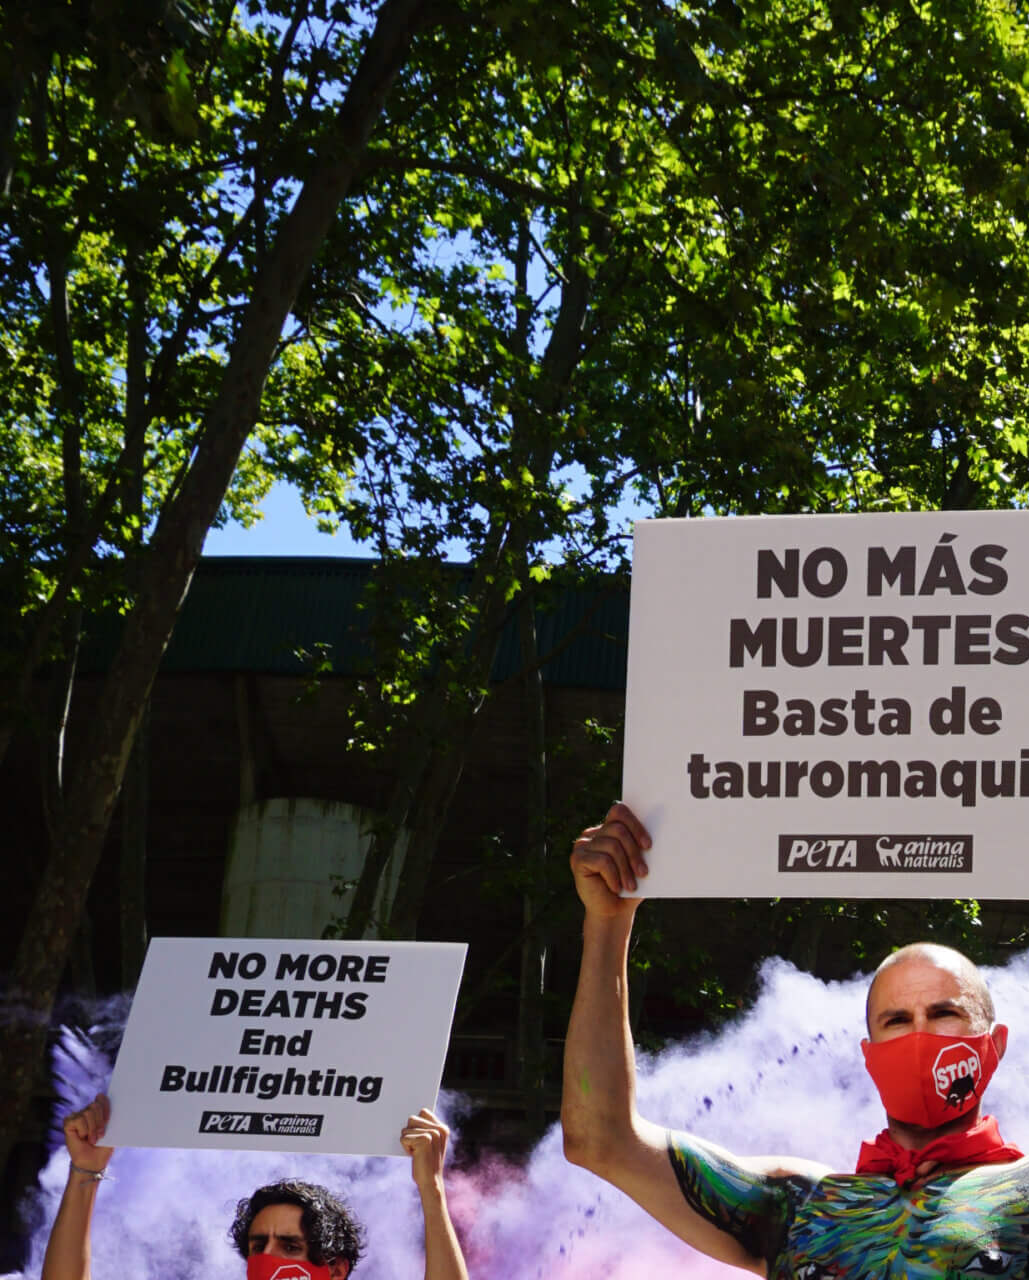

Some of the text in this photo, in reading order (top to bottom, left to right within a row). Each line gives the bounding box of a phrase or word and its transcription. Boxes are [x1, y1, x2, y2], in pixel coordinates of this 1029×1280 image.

[756, 532, 1009, 599] NO MÁS
[742, 686, 1003, 737] Basta de
[903, 837, 965, 855] anima
[903, 855, 965, 868] naturalis
[208, 952, 391, 983] NO MORE
[209, 988, 369, 1020] DEATHS
[238, 1028, 313, 1057] End
[159, 1065, 384, 1104] Bullfighting
[937, 1057, 978, 1089] STOP
